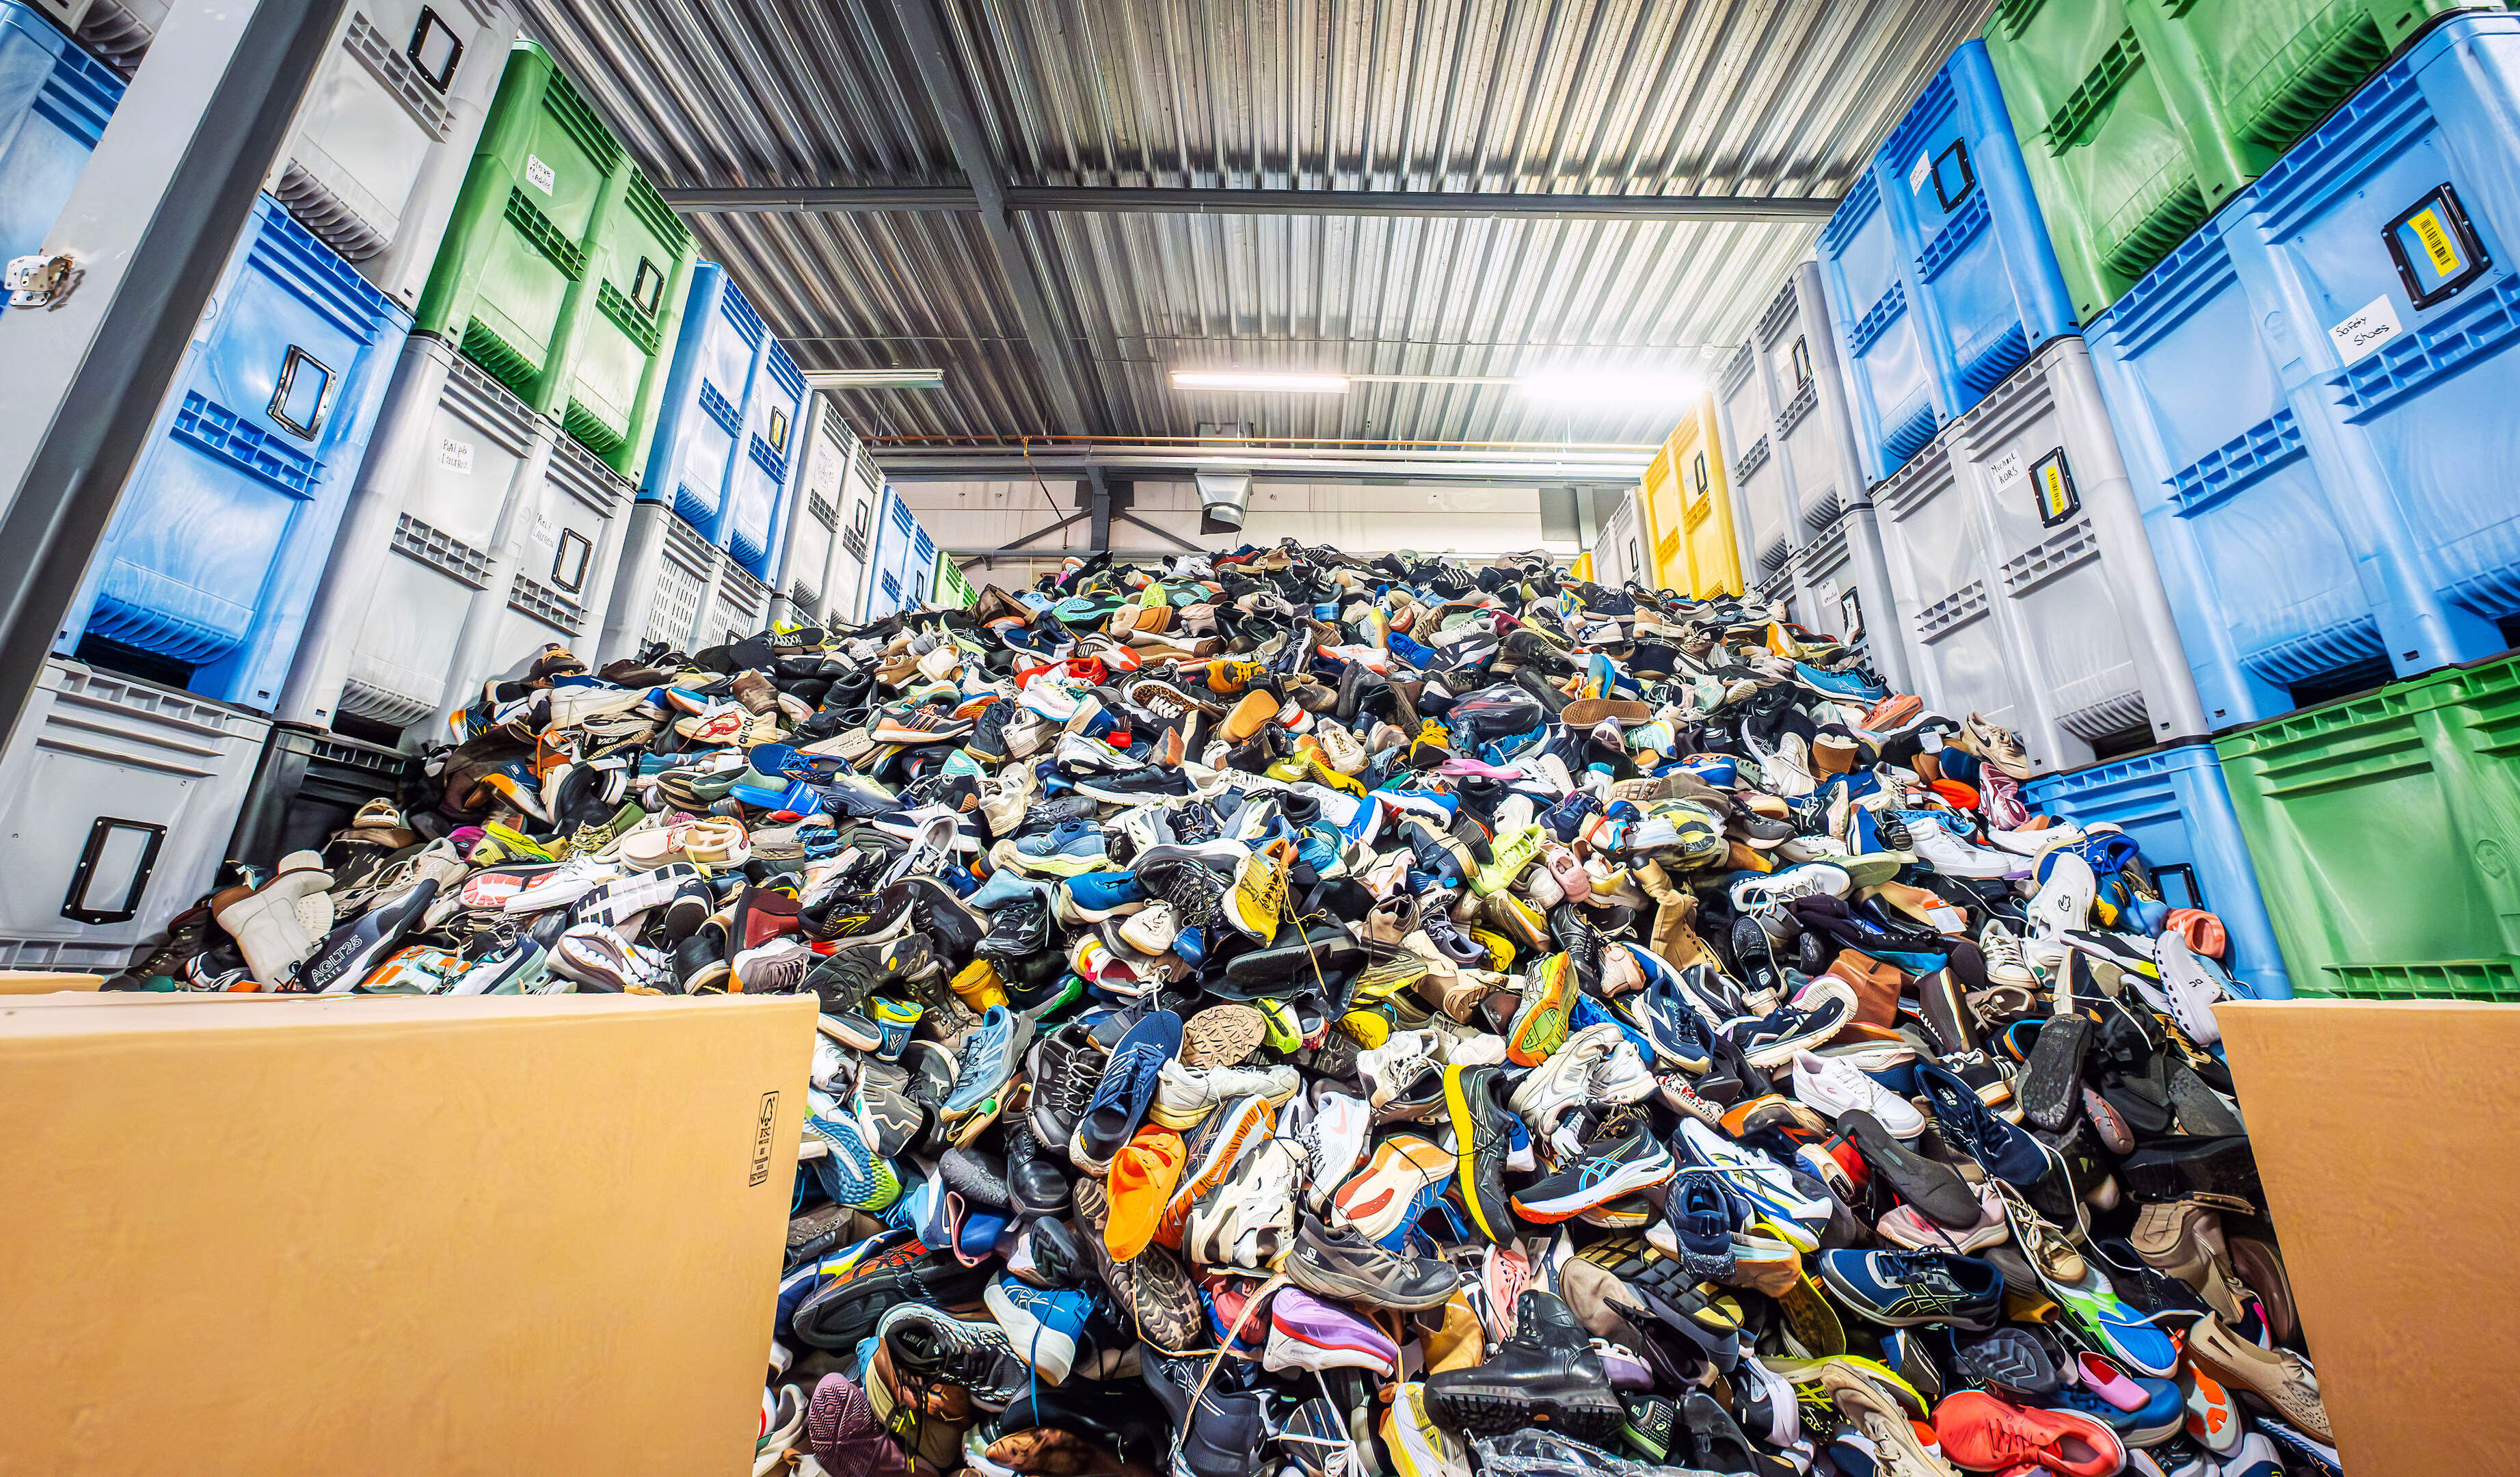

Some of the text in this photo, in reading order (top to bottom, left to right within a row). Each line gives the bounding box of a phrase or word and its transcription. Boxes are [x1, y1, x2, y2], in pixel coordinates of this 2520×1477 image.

[1998, 466, 2018, 485] KORS
[738, 717, 754, 744] GUCCI
[312, 934, 363, 983] AGLT25
